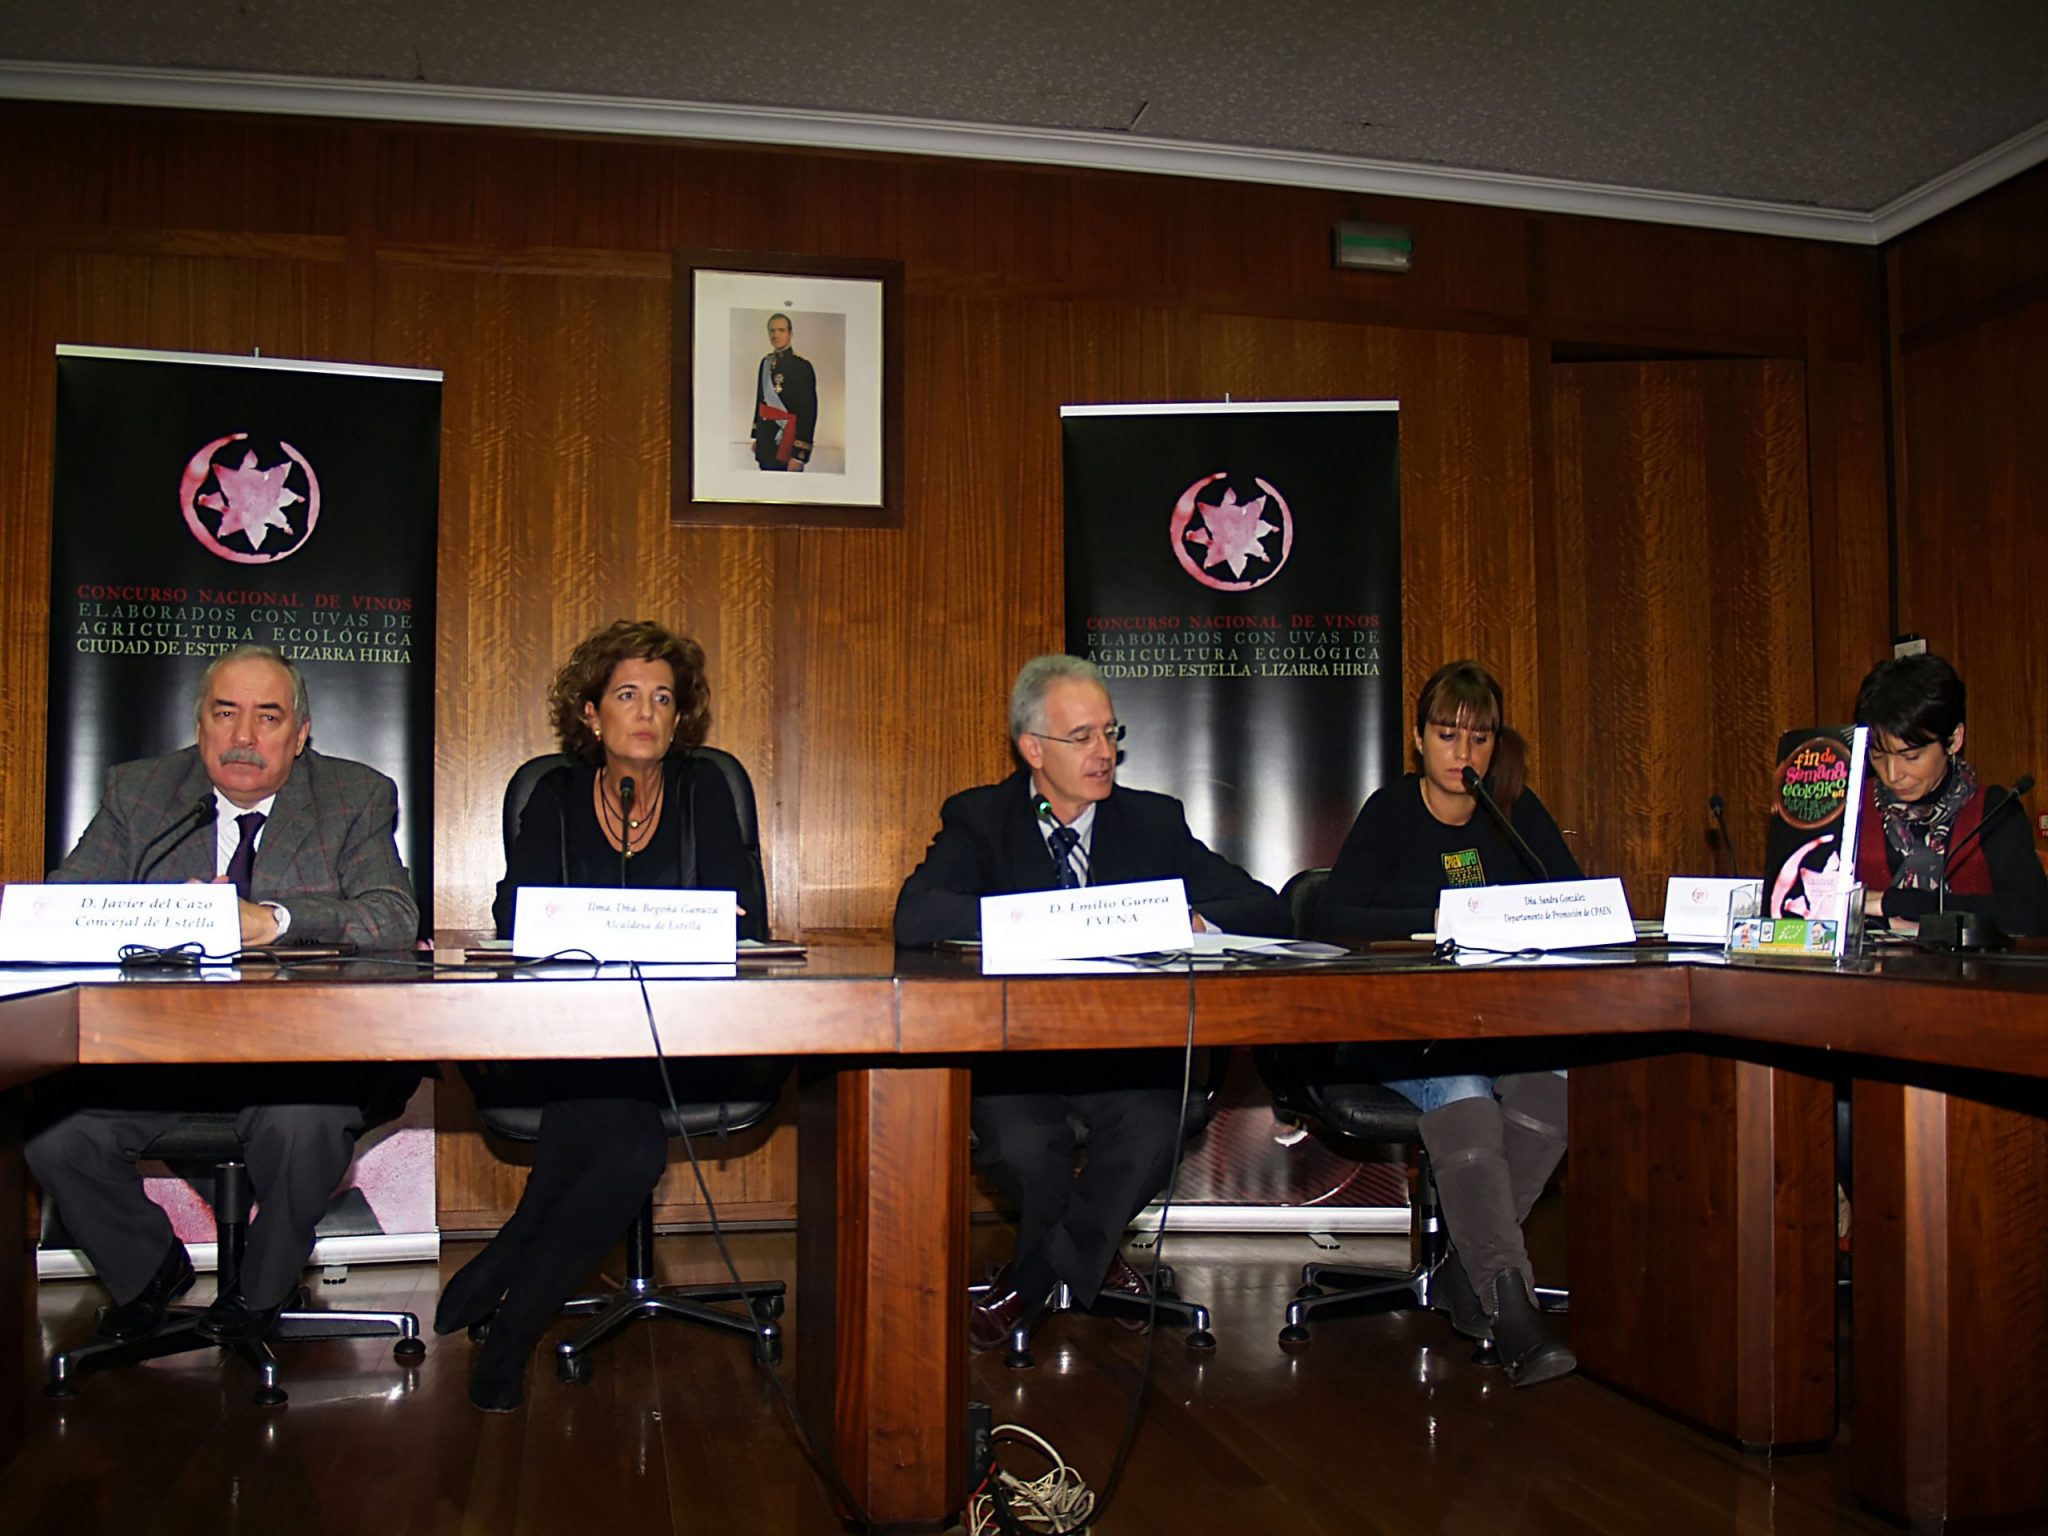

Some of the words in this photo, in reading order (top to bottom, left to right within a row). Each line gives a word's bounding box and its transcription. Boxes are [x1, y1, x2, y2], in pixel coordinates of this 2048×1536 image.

[77, 585, 187, 601] CONCURSO
[199, 589, 304, 607] NACIONAL
[315, 594, 342, 609] DE
[352, 596, 413, 612] VINOS
[78, 603, 236, 622] ELABORADOS
[250, 608, 298, 624] CON
[312, 611, 369, 627] UVAS
[384, 614, 413, 629] DE
[1087, 616, 1180, 630] CONCURSO
[1189, 615, 1281, 629] NACIONAL
[1292, 615, 1315, 628] DE
[1326, 614, 1380, 628] VINOS
[77, 621, 254, 641] AGRICULTURA
[274, 625, 413, 646] ECOLÓGICA
[1087, 631, 1223, 646] ELABORADOS
[1235, 631, 1276, 645] CON
[1289, 630, 1341, 644] UVAS
[1353, 630, 1380, 644] DE
[77, 638, 150, 655] CIUDAD
[154, 640, 180, 656] DE
[280, 645, 355, 662] LIZARRA
[359, 649, 413, 664] HIRIA
[1087, 647, 1239, 662] AGRICULTURA
[1254, 644, 1380, 660] ECOLÓGICA
[1152, 663, 1176, 678] DE
[1178, 663, 1252, 678] ESTELLA
[1261, 663, 1329, 677] LIZARRA
[1333, 662, 1380, 676] HIRIA
[1794, 749, 1820, 770] fin
[81, 897, 96, 909] D.
[101, 897, 145, 911] Javier
[149, 897, 172, 909] del
[1070, 899, 1117, 912] Emilio
[75, 914, 139, 930] Concejal
[143, 915, 161, 928] de
[164, 916, 214, 928] Estella
